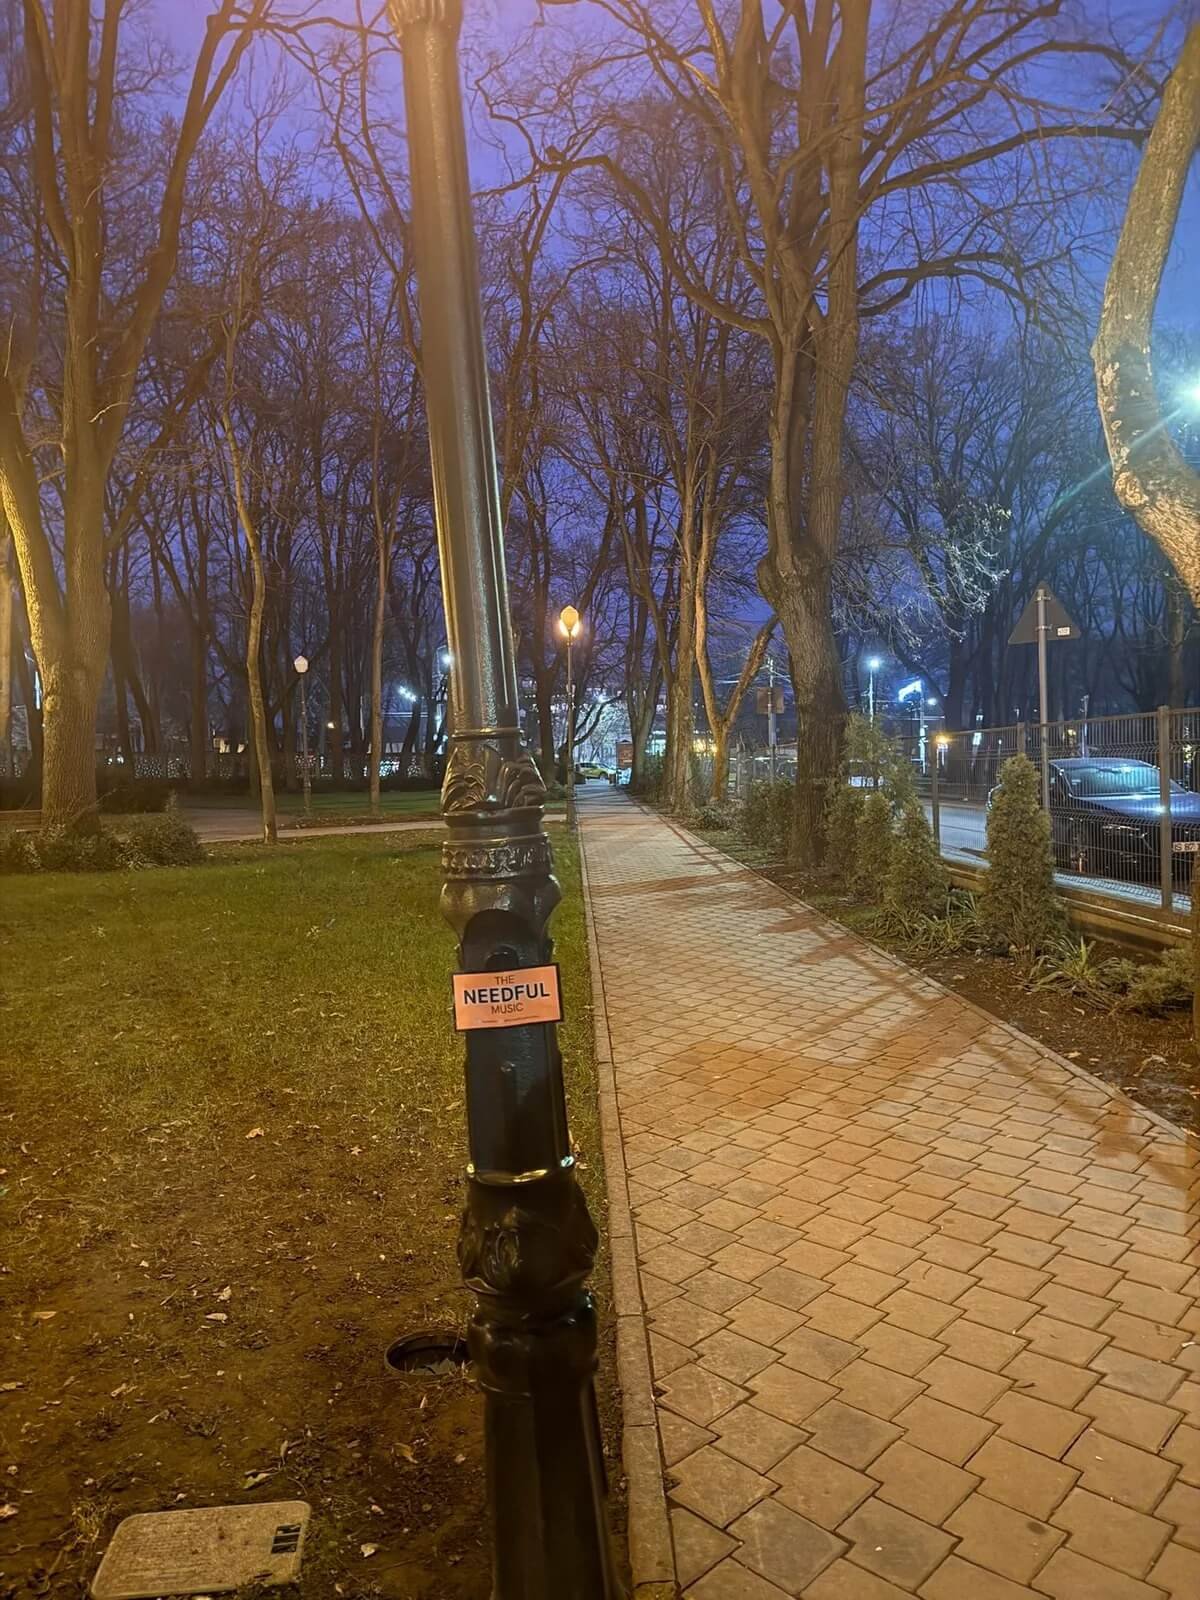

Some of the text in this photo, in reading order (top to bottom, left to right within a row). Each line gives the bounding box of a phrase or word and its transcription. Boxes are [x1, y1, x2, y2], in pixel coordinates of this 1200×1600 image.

[494, 975, 515, 985] THE
[463, 982, 550, 1004] NEEDFUL
[491, 1002, 524, 1015] MUSIC
